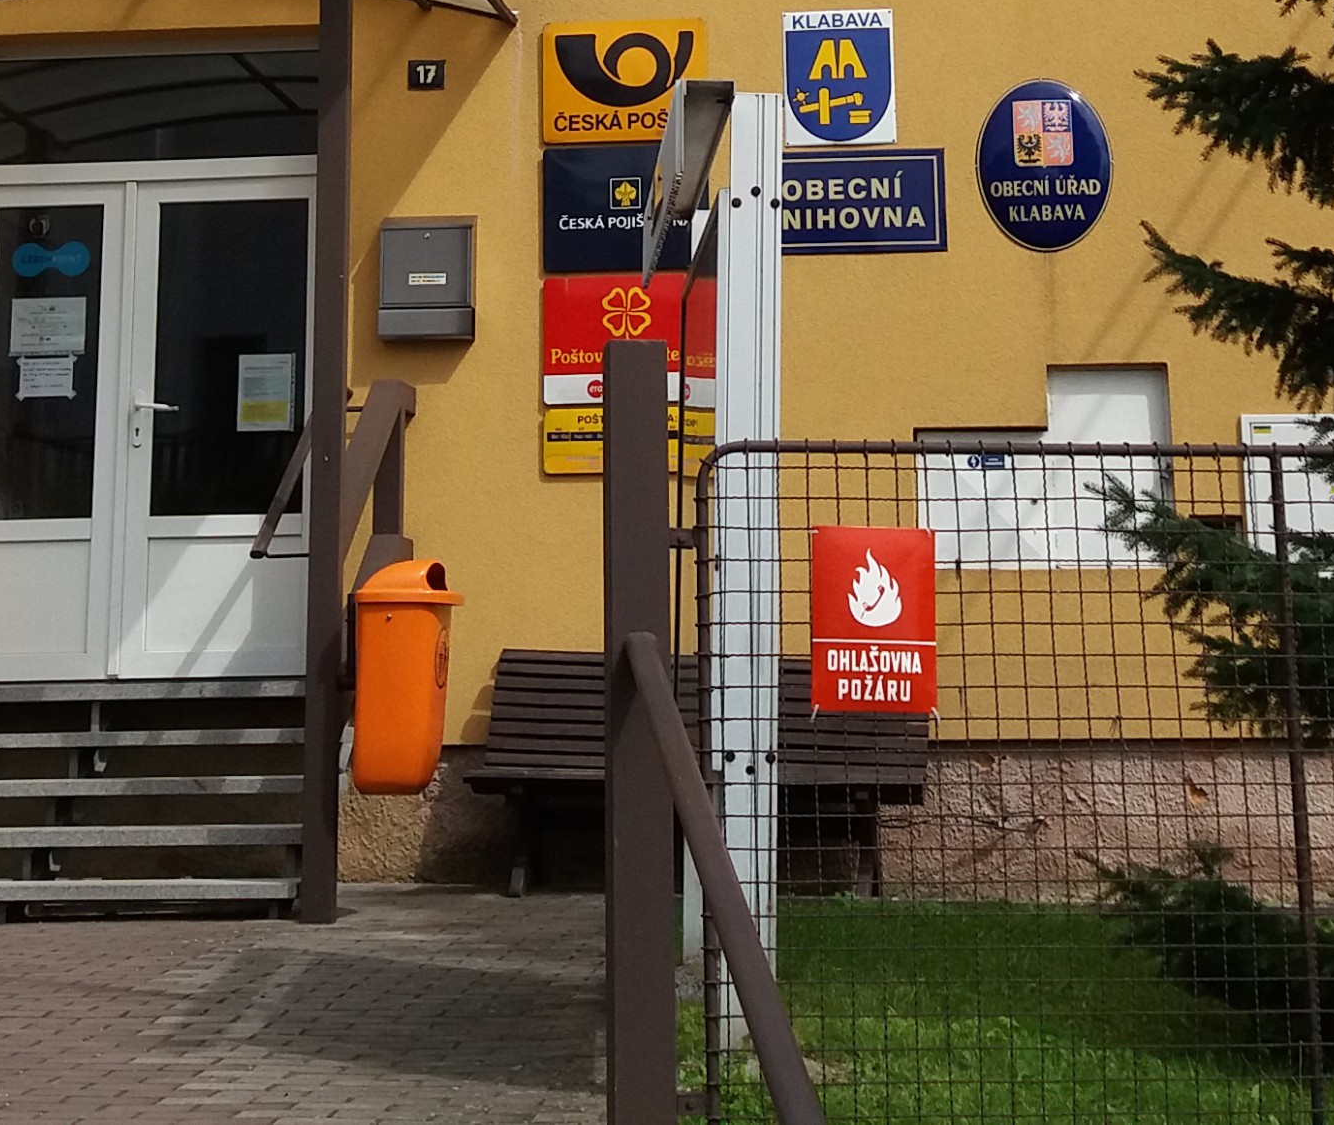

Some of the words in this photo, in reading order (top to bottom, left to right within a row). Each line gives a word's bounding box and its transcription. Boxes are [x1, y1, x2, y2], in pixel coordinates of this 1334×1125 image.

[793, 12, 882, 29] KLABAVA
[416, 65, 437, 84] 17
[554, 110, 622, 132] ČESKÁ
[628, 108, 669, 130] POŠ
[782, 170, 903, 202] OBECNÍ
[990, 175, 1050, 197] OBECNÍ
[1055, 175, 1101, 195] ÚŘAD
[559, 214, 605, 230] ČESKÁ
[782, 206, 926, 230] NIHOVNA
[1009, 204, 1086, 222] KLABAVA
[551, 348, 603, 364] Poštov
[578, 414, 603, 424] POŠT
[827, 645, 922, 674] OHLAŠOVNA
[838, 675, 911, 702] POŽÁRU
